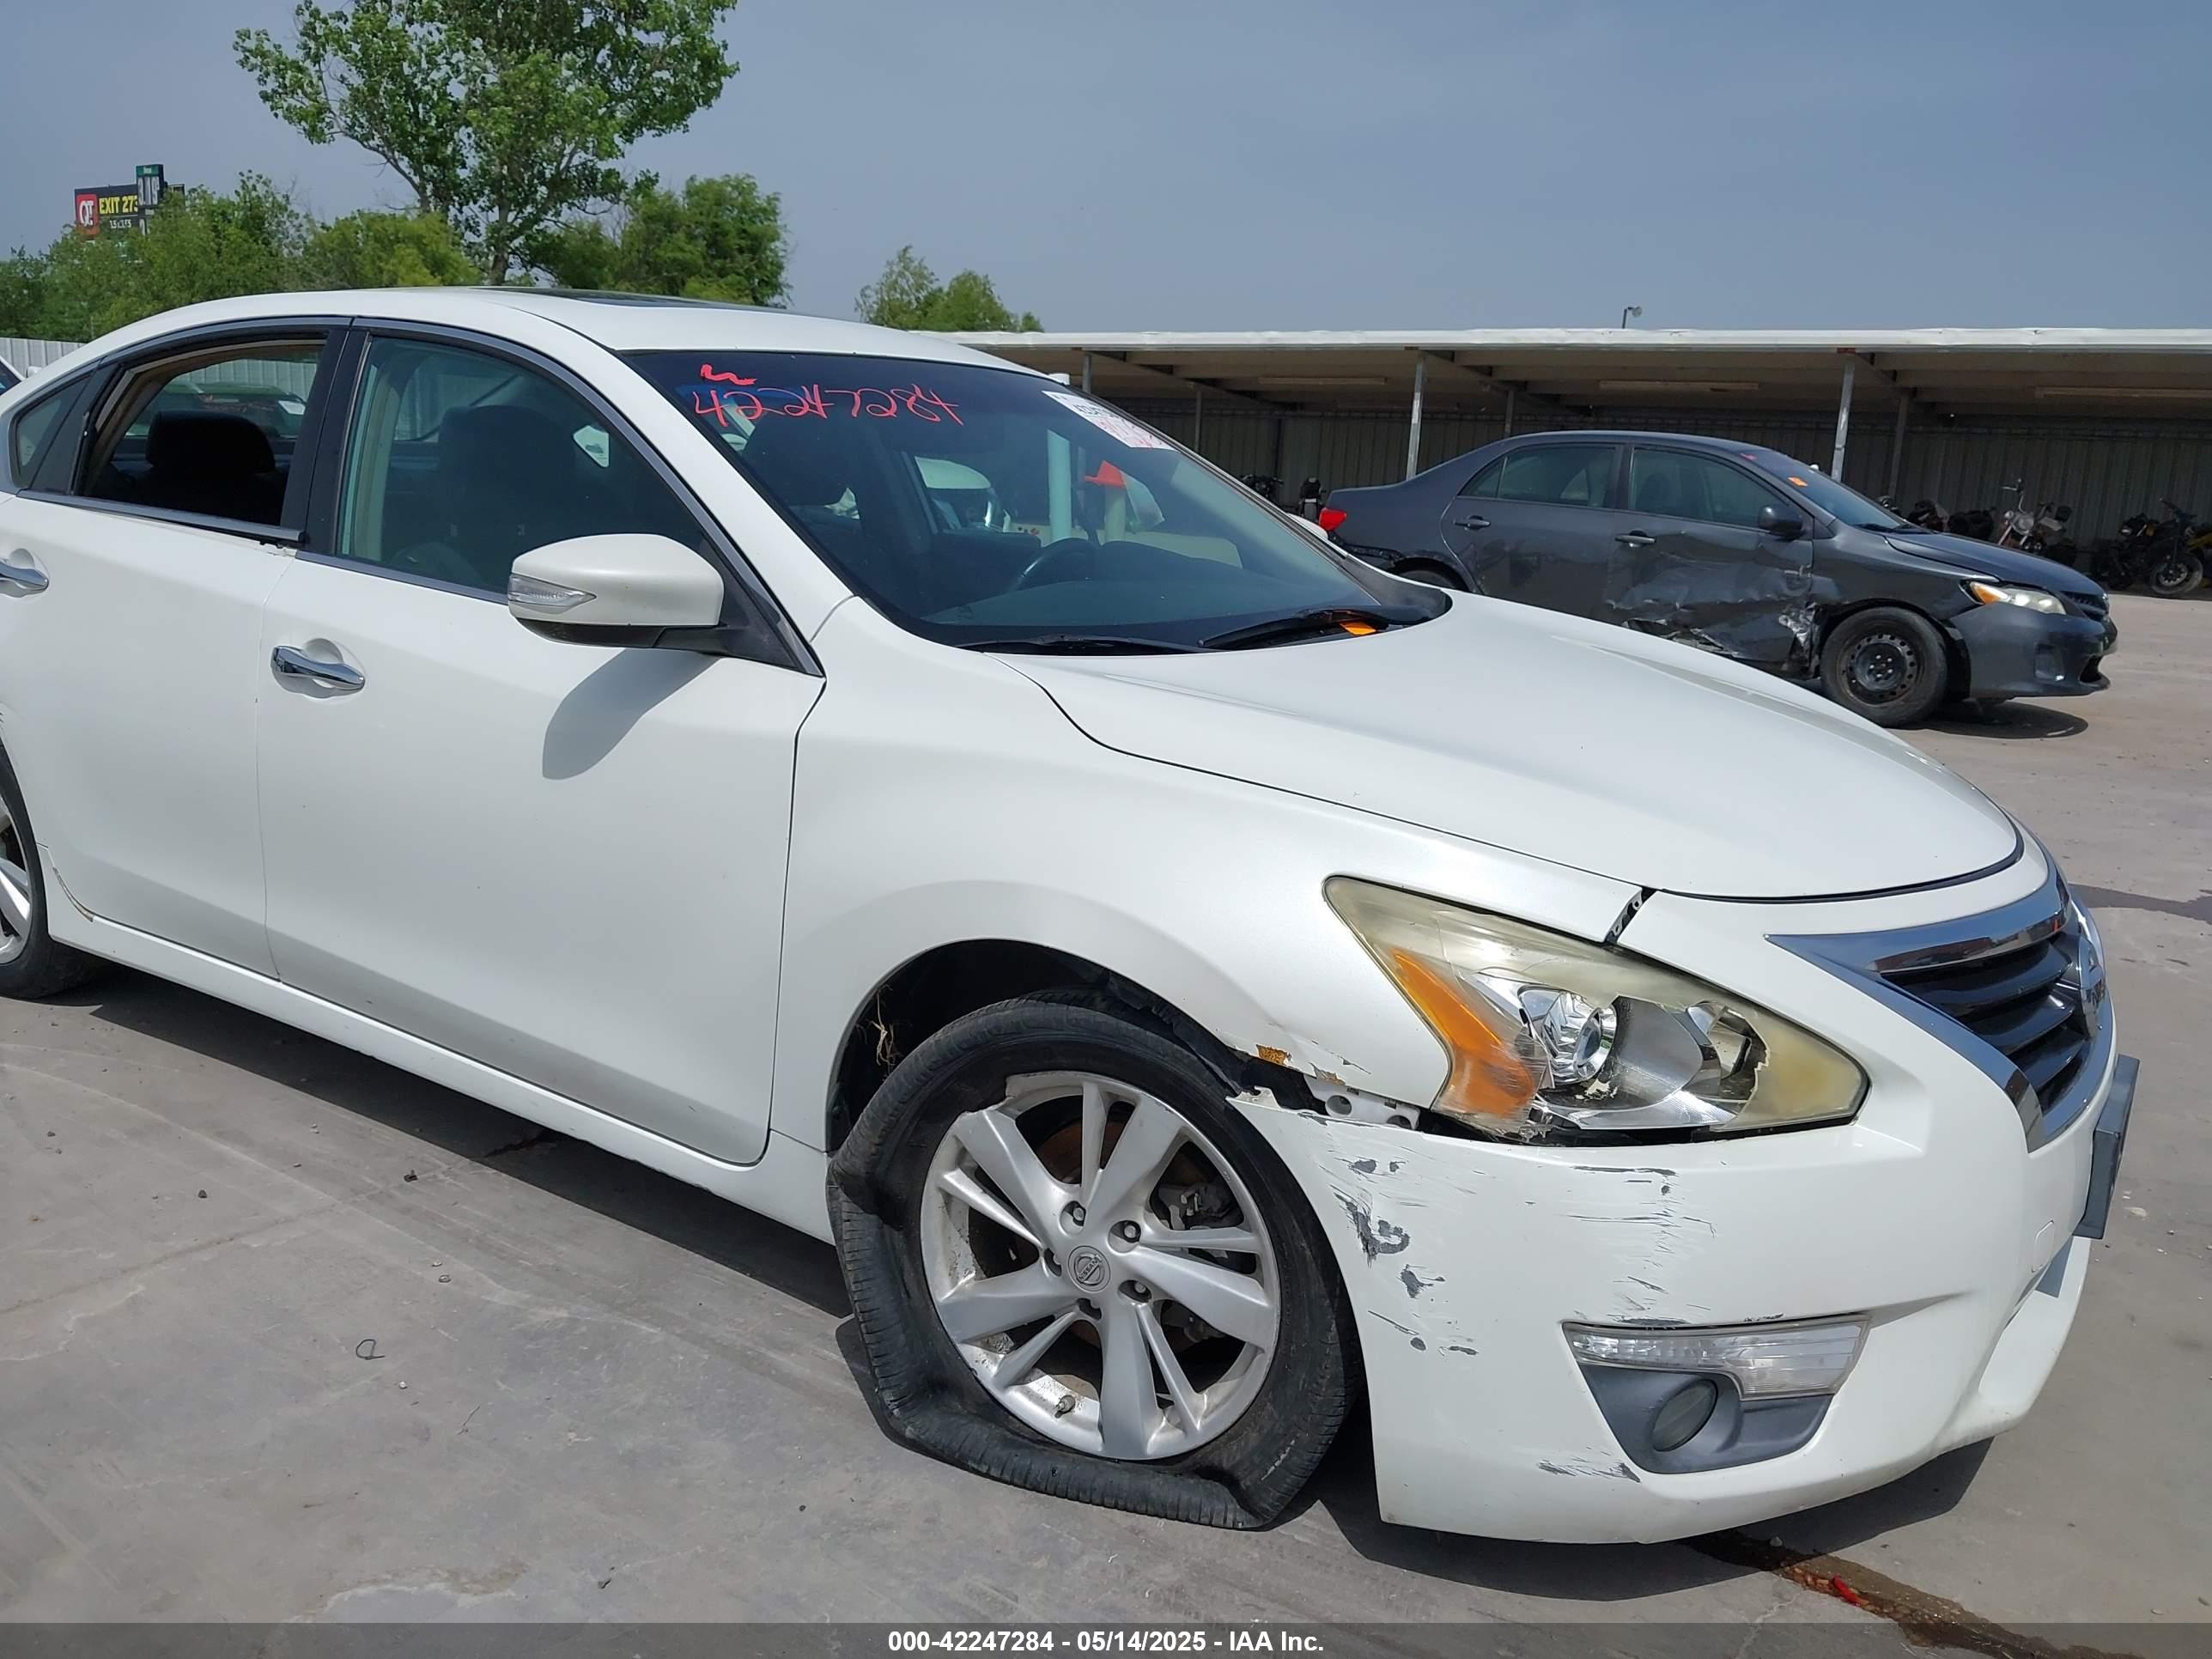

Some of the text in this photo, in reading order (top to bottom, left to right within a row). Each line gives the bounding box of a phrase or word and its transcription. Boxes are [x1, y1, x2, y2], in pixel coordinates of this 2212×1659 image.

[79, 200, 94, 227] QT
[99, 197, 120, 215] EXIT
[692, 383, 964, 427] 42247284
[1078, 1254, 1103, 1281] NISSAN
